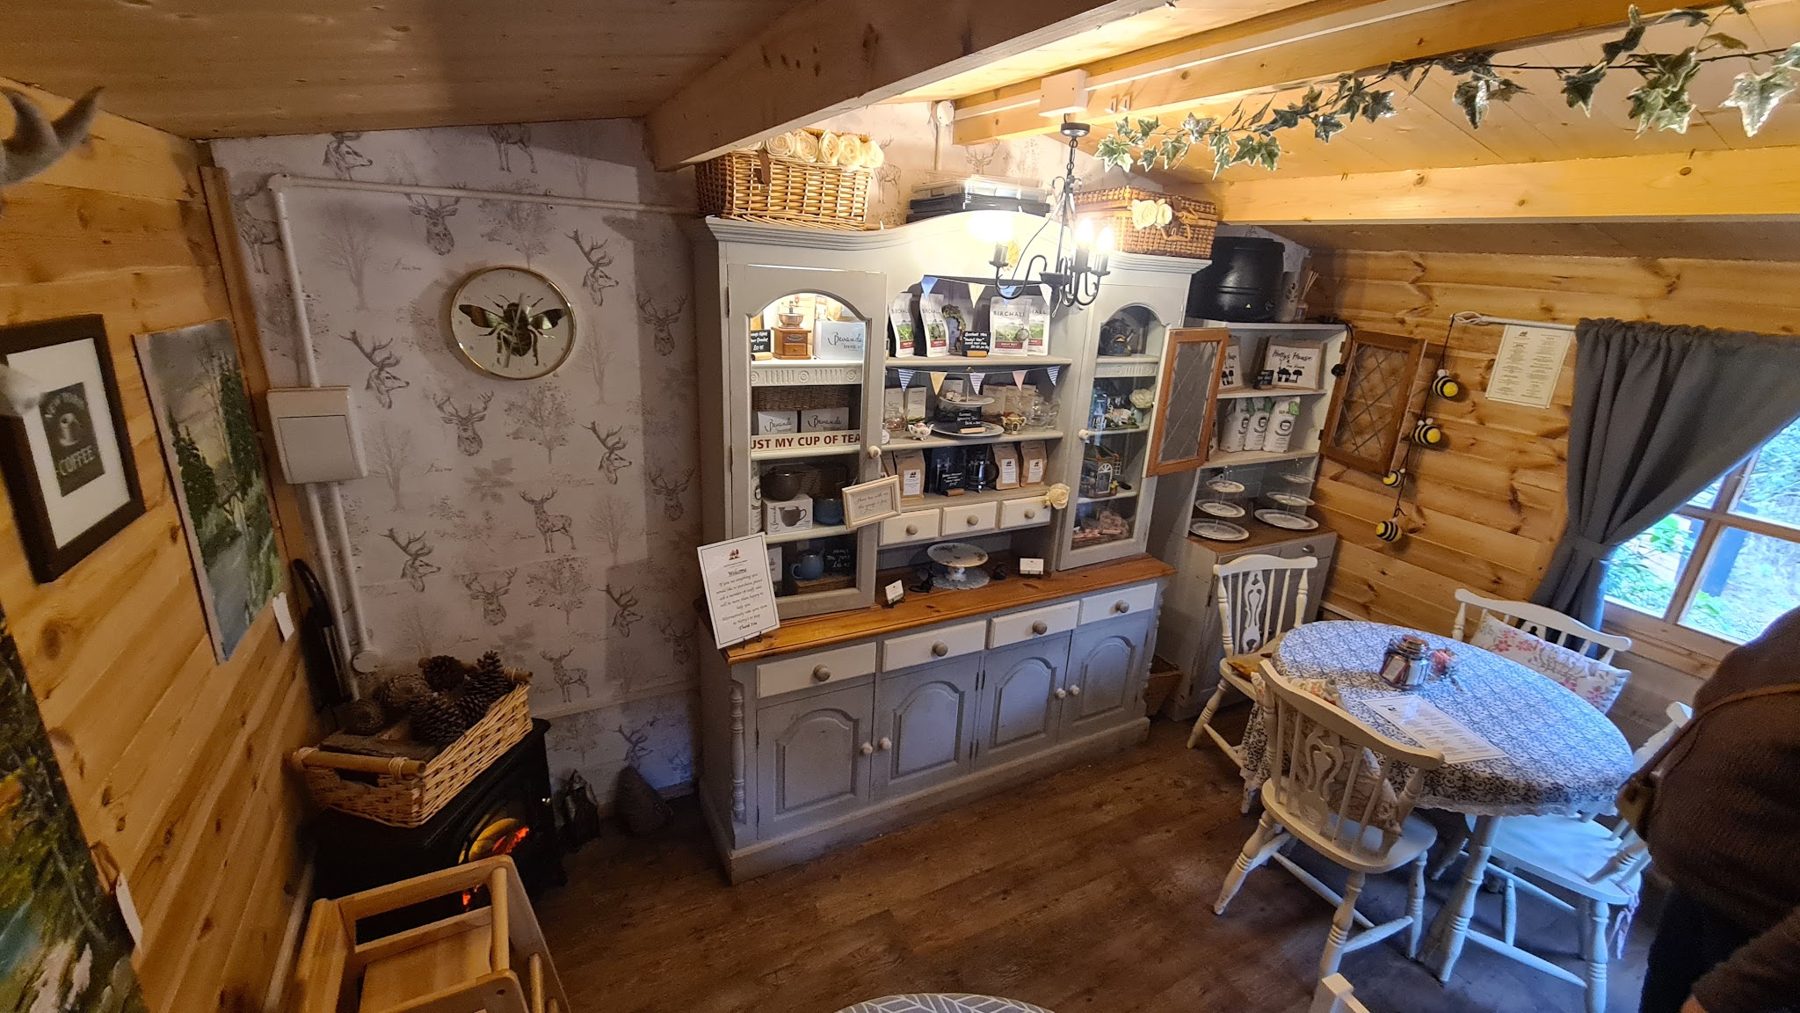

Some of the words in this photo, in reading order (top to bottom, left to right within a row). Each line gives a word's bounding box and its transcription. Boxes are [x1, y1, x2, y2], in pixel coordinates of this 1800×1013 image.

[750, 439, 772, 450] UST
[775, 438, 794, 448] MY
[797, 436, 820, 446] CUP
[823, 435, 838, 445] OF
[841, 433, 861, 443] TEA
[59, 445, 95, 476] COFFEE
